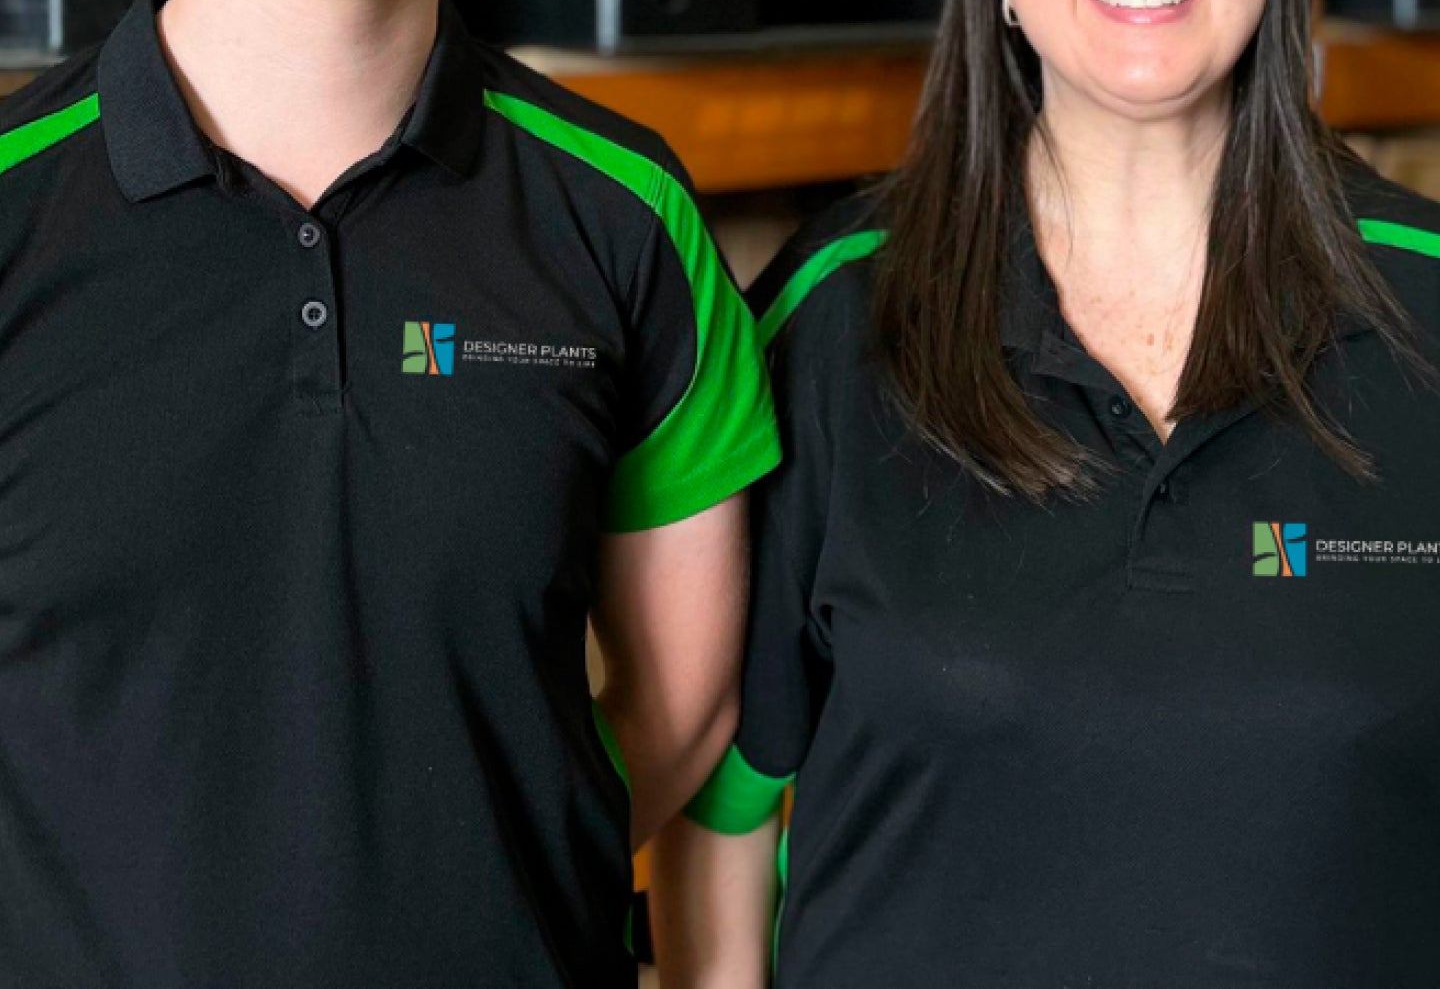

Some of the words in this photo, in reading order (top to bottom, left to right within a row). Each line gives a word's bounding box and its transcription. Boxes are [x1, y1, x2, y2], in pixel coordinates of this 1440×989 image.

[463, 340, 537, 355] DESIGNER
[540, 345, 597, 360] PLANTS
[1315, 540, 1394, 553] DESIGNER
